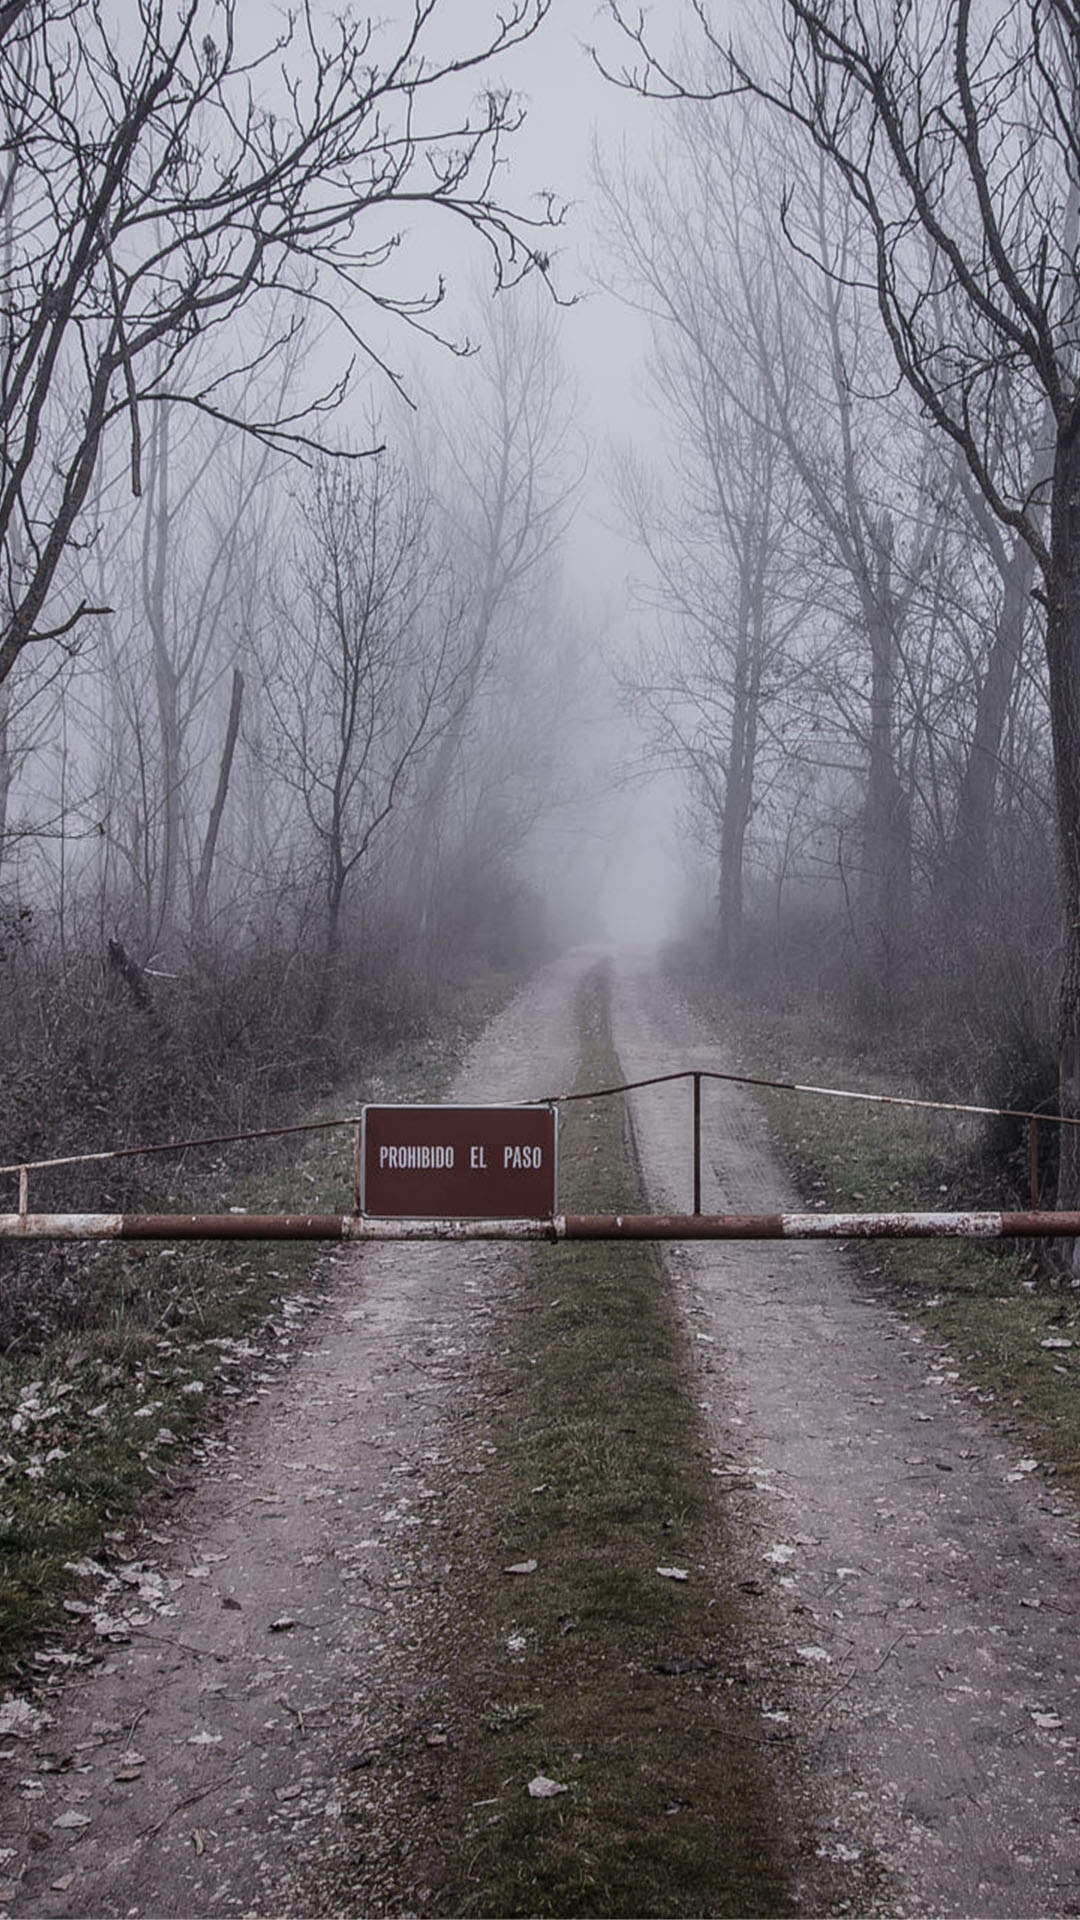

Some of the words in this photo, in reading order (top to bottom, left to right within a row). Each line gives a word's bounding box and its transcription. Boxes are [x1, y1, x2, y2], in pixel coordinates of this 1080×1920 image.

[380, 1146, 454, 1168] PROHIBIDO
[470, 1146, 487, 1168] EL
[504, 1146, 542, 1168] PASO
